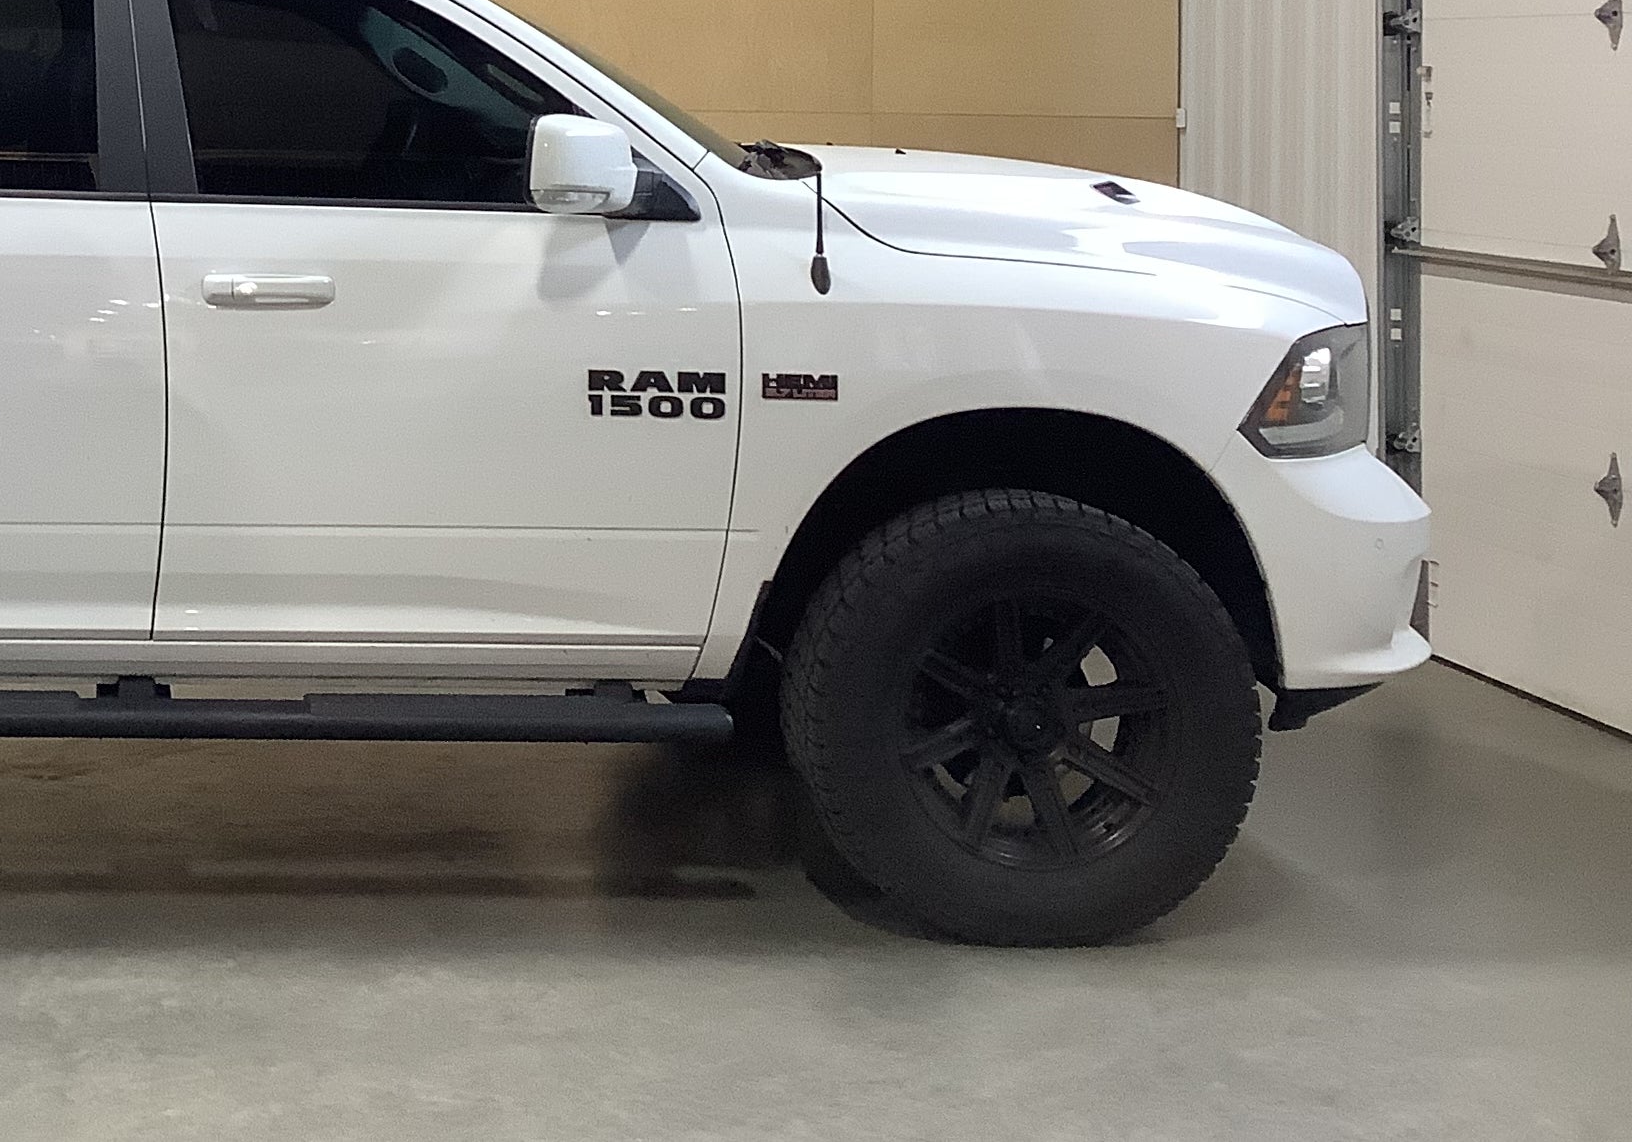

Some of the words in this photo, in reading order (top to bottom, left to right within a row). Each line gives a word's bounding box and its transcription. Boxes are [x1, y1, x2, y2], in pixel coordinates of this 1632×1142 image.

[588, 369, 726, 394] RAM
[762, 372, 838, 389] HEMI
[588, 394, 726, 419] 1500
